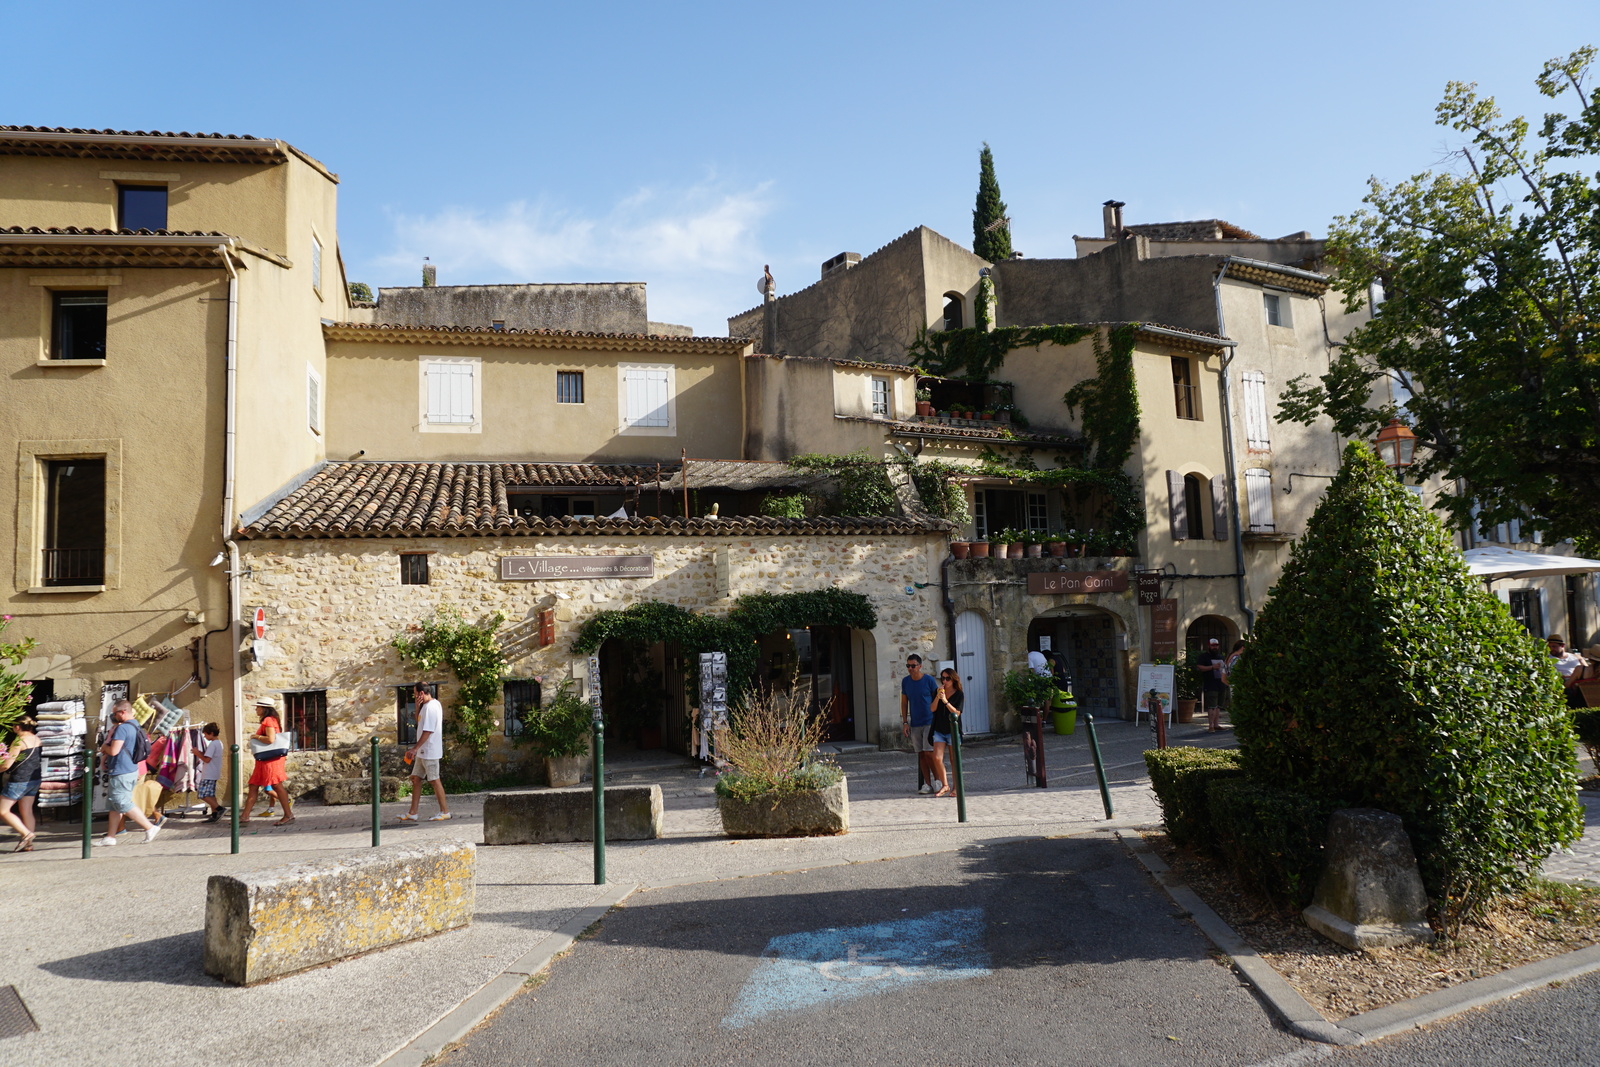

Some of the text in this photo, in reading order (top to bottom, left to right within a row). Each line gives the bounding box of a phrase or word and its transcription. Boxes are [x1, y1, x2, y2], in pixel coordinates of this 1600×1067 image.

[508, 561, 526, 576] Le
[582, 565, 613, 573] Vêtements
[619, 564, 650, 573] Décoration
[1044, 575, 1114, 590] Le Pan Garni
[1139, 577, 1159, 586] Snack
[1140, 590, 1158, 603] Pizza
[1156, 604, 1173, 612] SNACK
